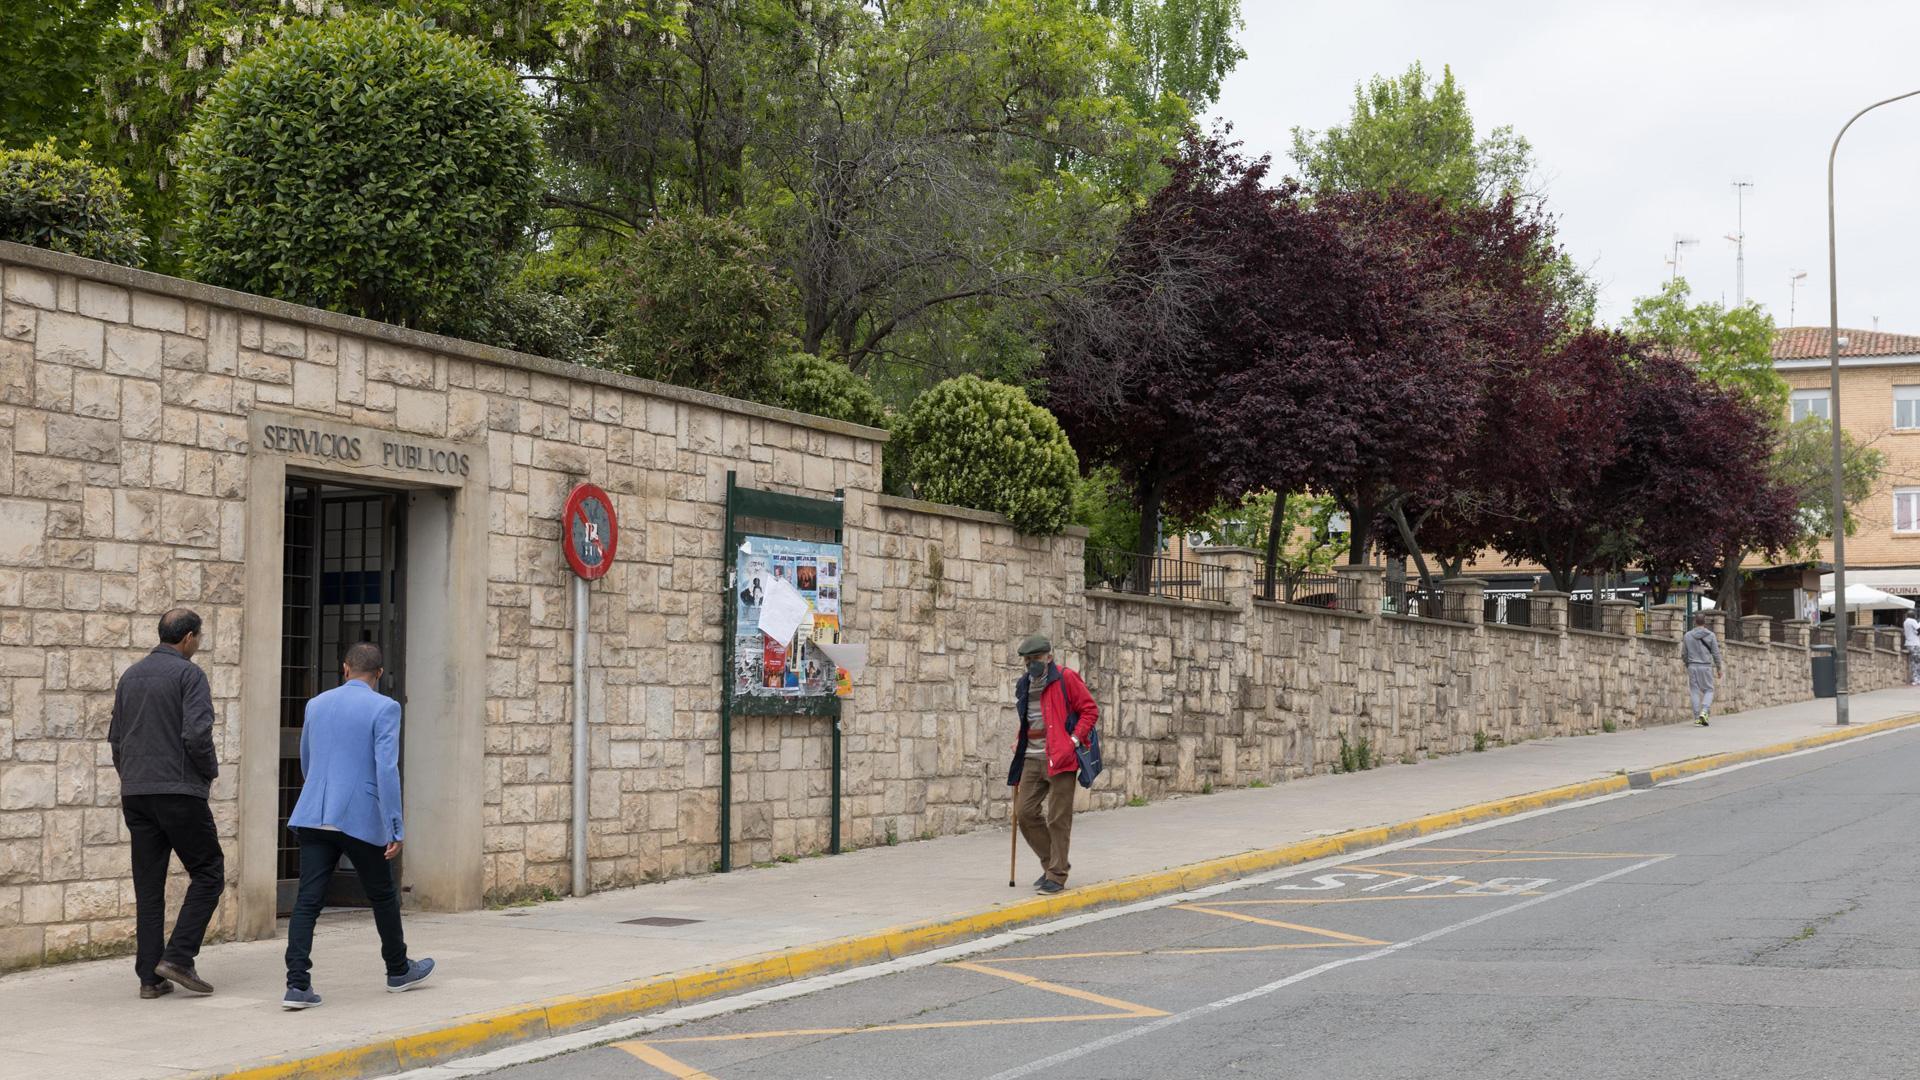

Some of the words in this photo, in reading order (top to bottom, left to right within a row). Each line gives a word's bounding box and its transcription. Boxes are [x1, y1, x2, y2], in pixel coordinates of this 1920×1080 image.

[263, 425, 361, 461] SERVICIOS
[382, 442, 470, 477] PUBLICOS
[1274, 874, 1557, 896] BUS
